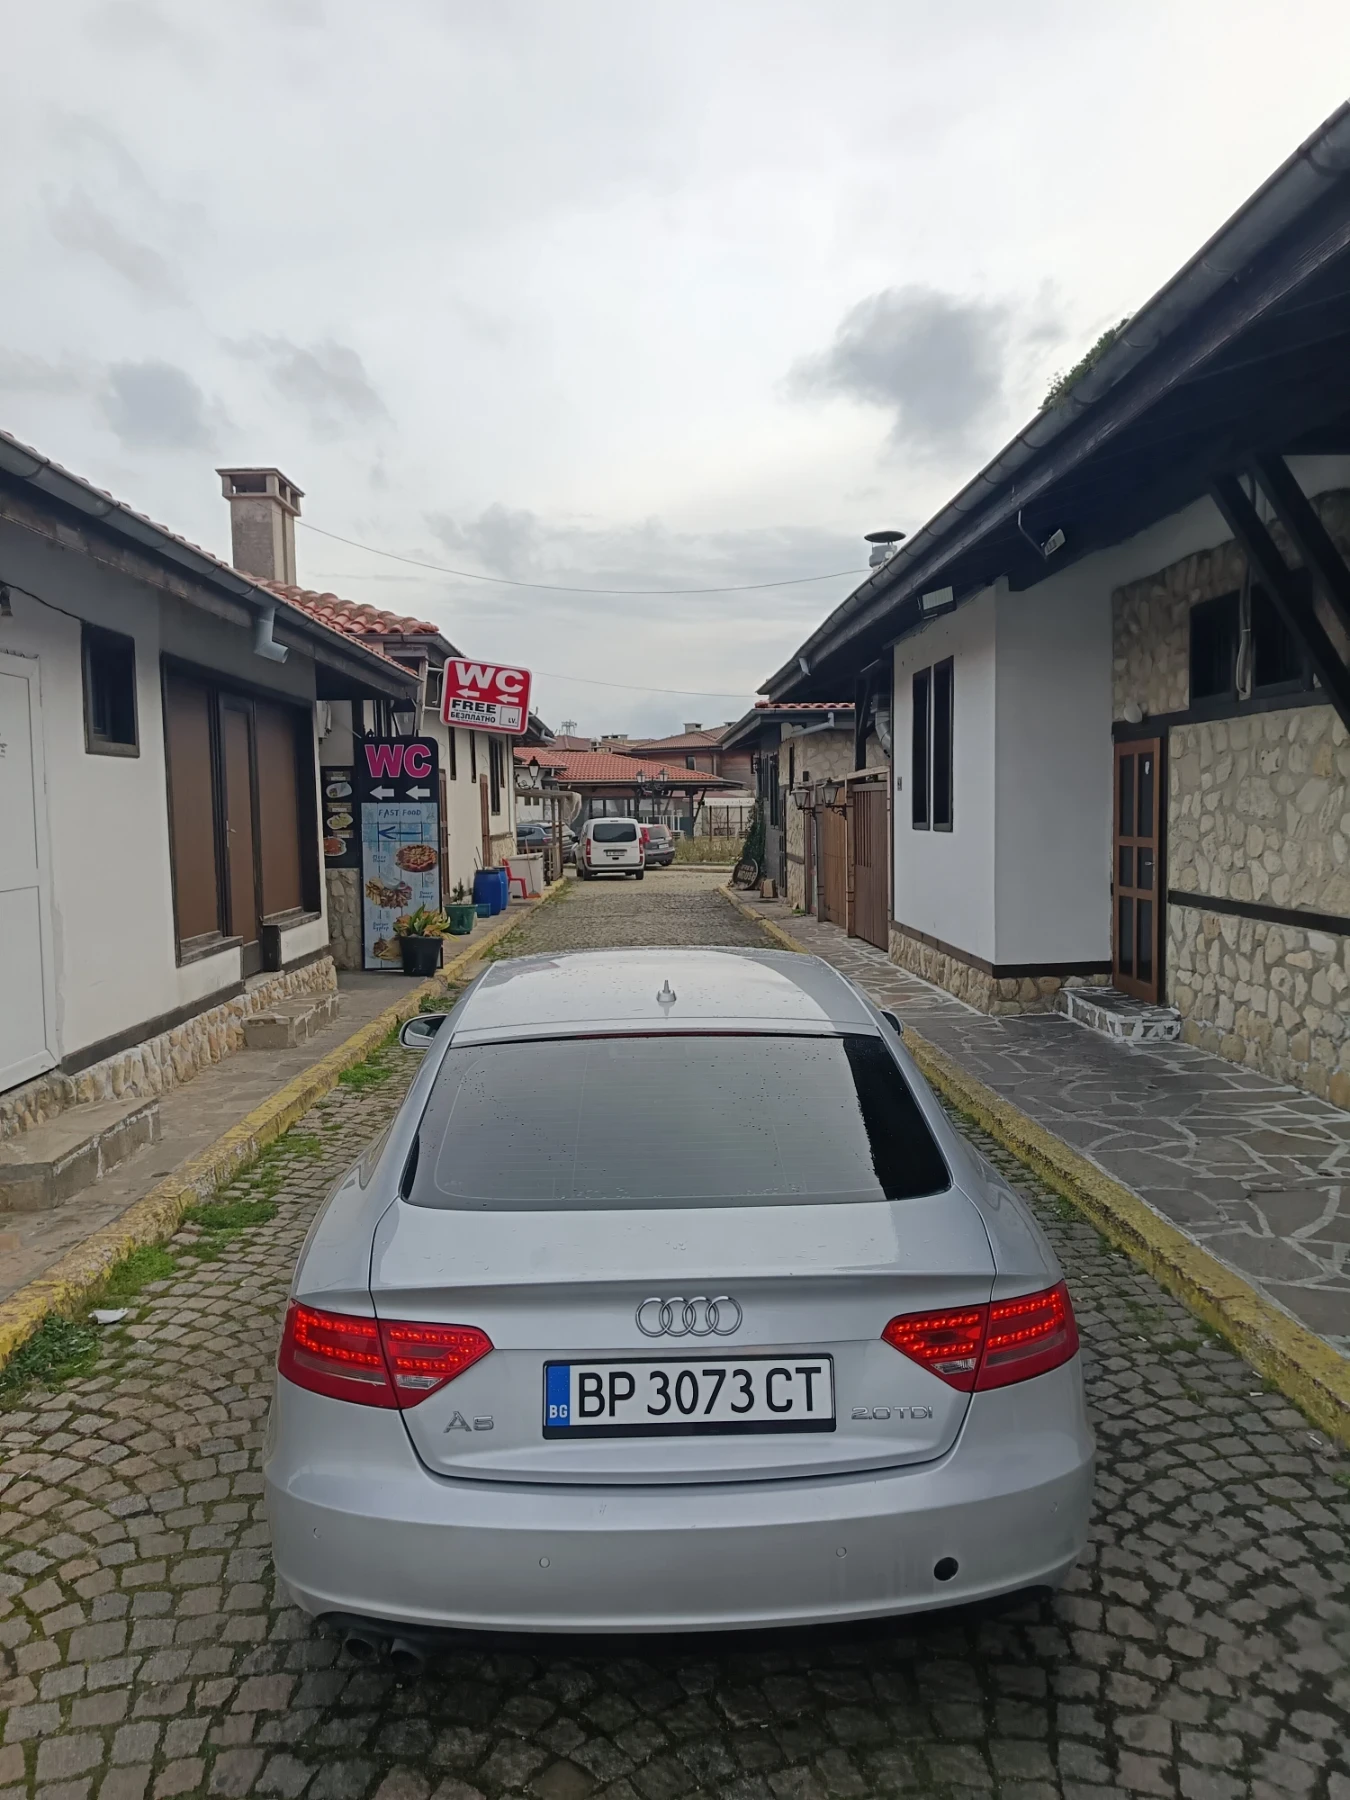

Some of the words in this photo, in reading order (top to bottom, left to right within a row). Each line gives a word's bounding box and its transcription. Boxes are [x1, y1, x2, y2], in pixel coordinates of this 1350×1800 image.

[455, 662, 524, 693] WC
[452, 699, 497, 714] FREE
[450, 712, 496, 724] БЕЗПЛАТНО
[364, 744, 432, 778] WC
[378, 808, 400, 818] FAST
[578, 1371, 635, 1418] BP
[647, 1369, 755, 1415] 3073
[766, 1366, 822, 1413] CT
[549, 1404, 568, 1419] BG
[851, 1406, 891, 1420] 2.0
[894, 1406, 933, 1419] TDI
[443, 1410, 494, 1433] A5
